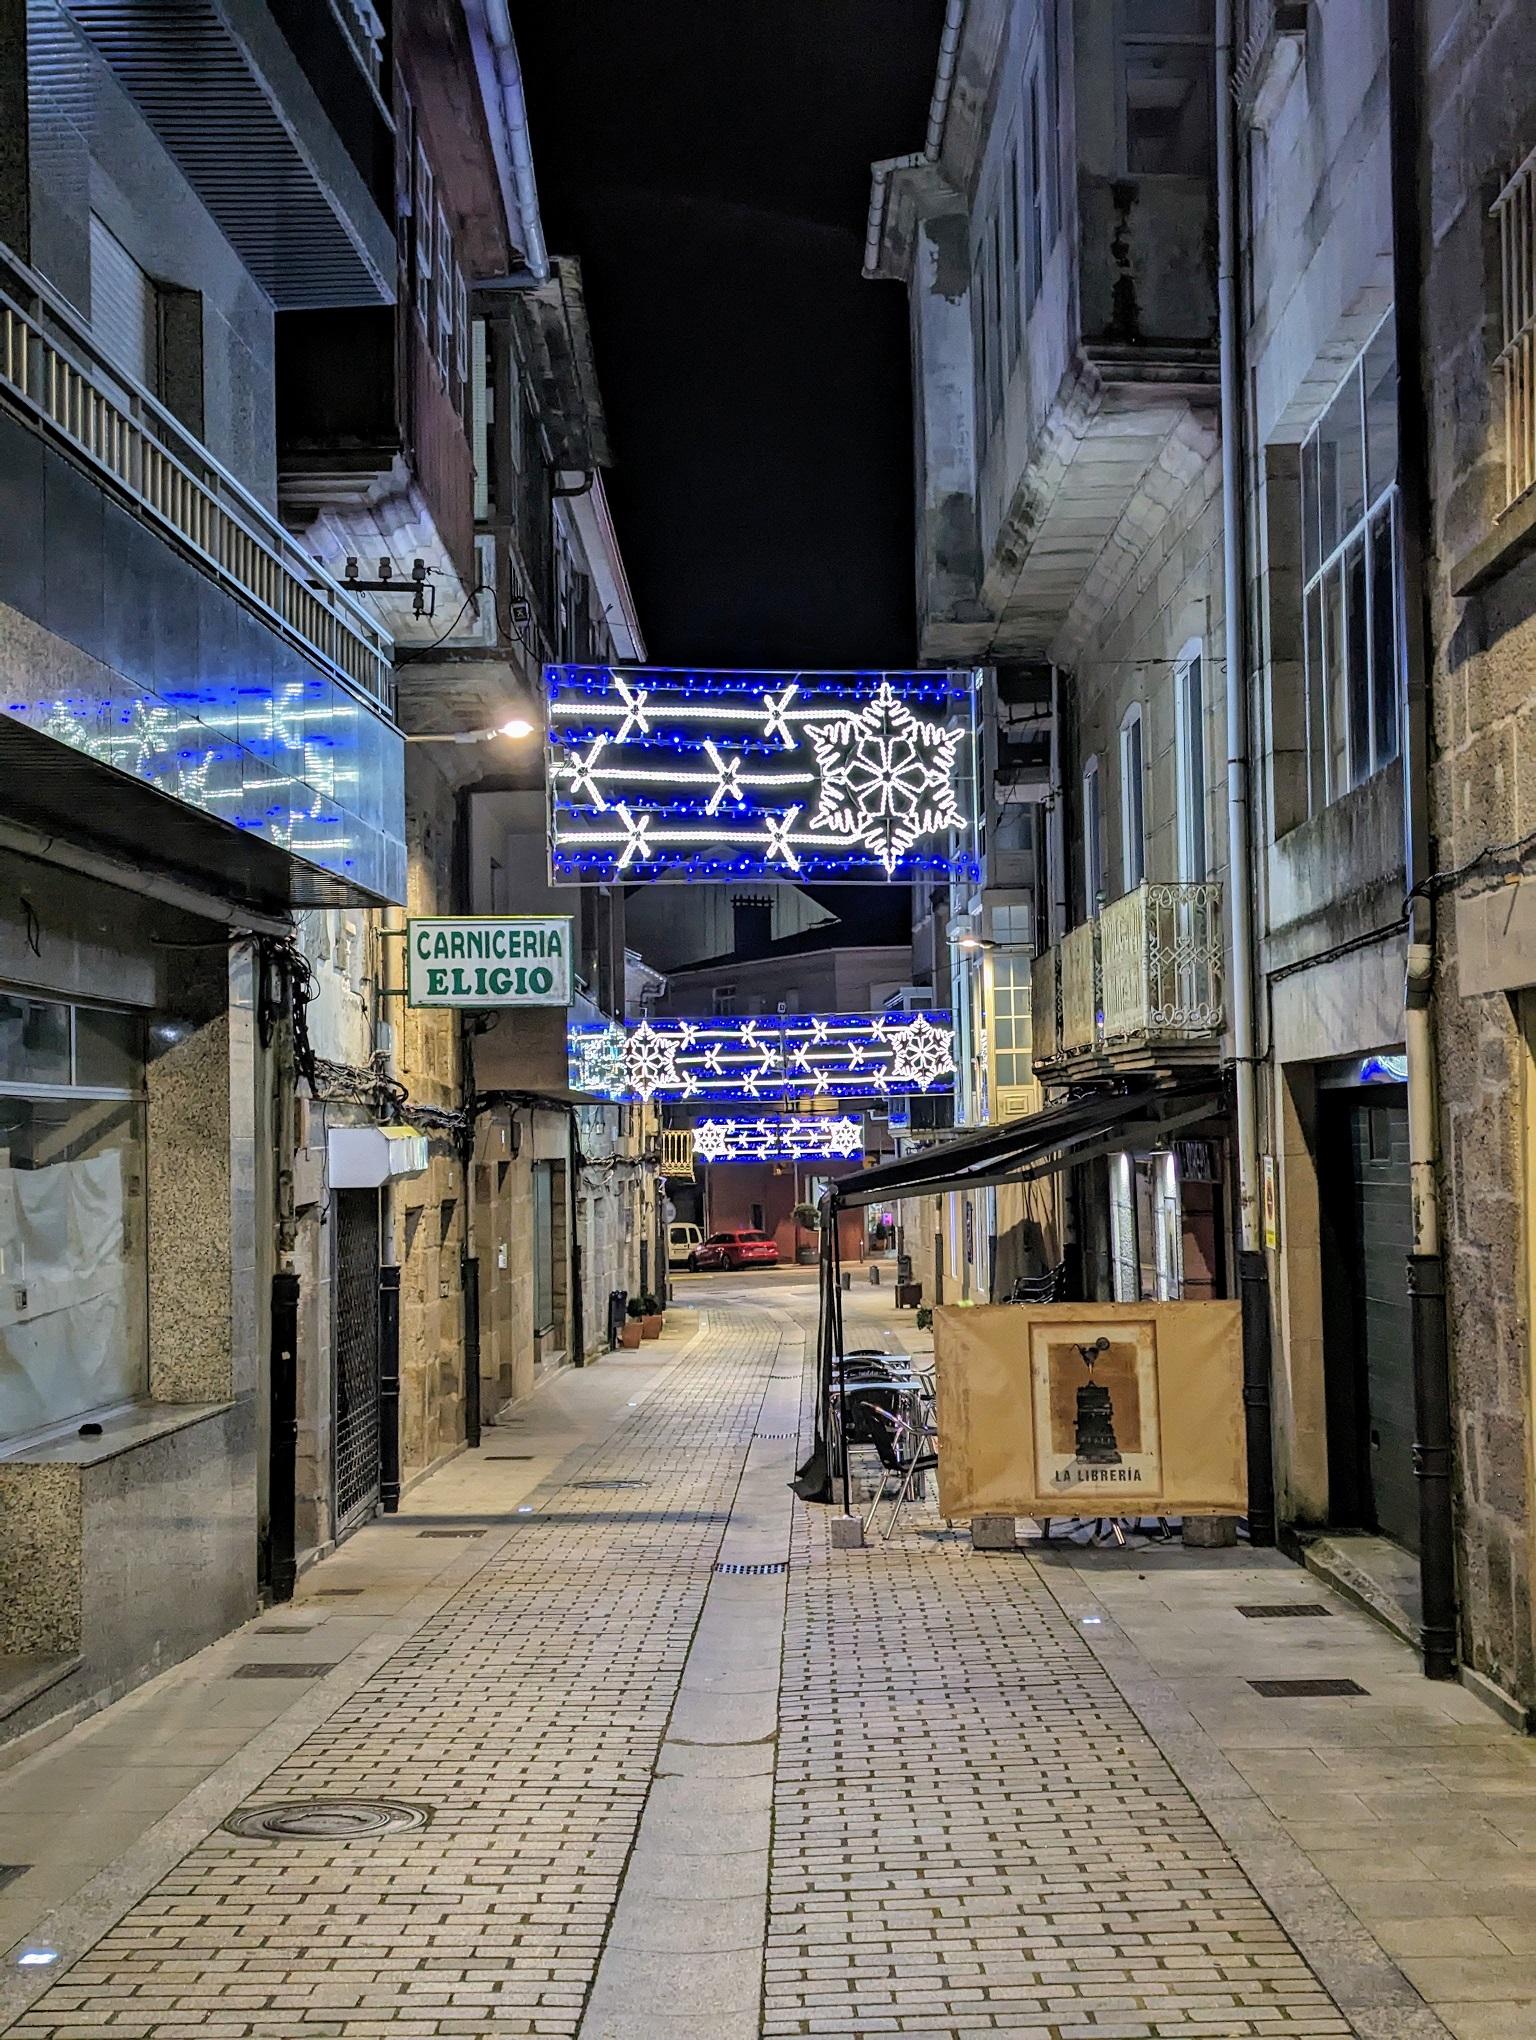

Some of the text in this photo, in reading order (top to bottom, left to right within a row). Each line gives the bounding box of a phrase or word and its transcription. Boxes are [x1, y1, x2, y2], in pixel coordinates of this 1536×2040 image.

[417, 930, 562, 960] CARNICERIA
[426, 966, 553, 995] ELIGIO
[1055, 1467, 1142, 1482] LA LIBRERÍA
